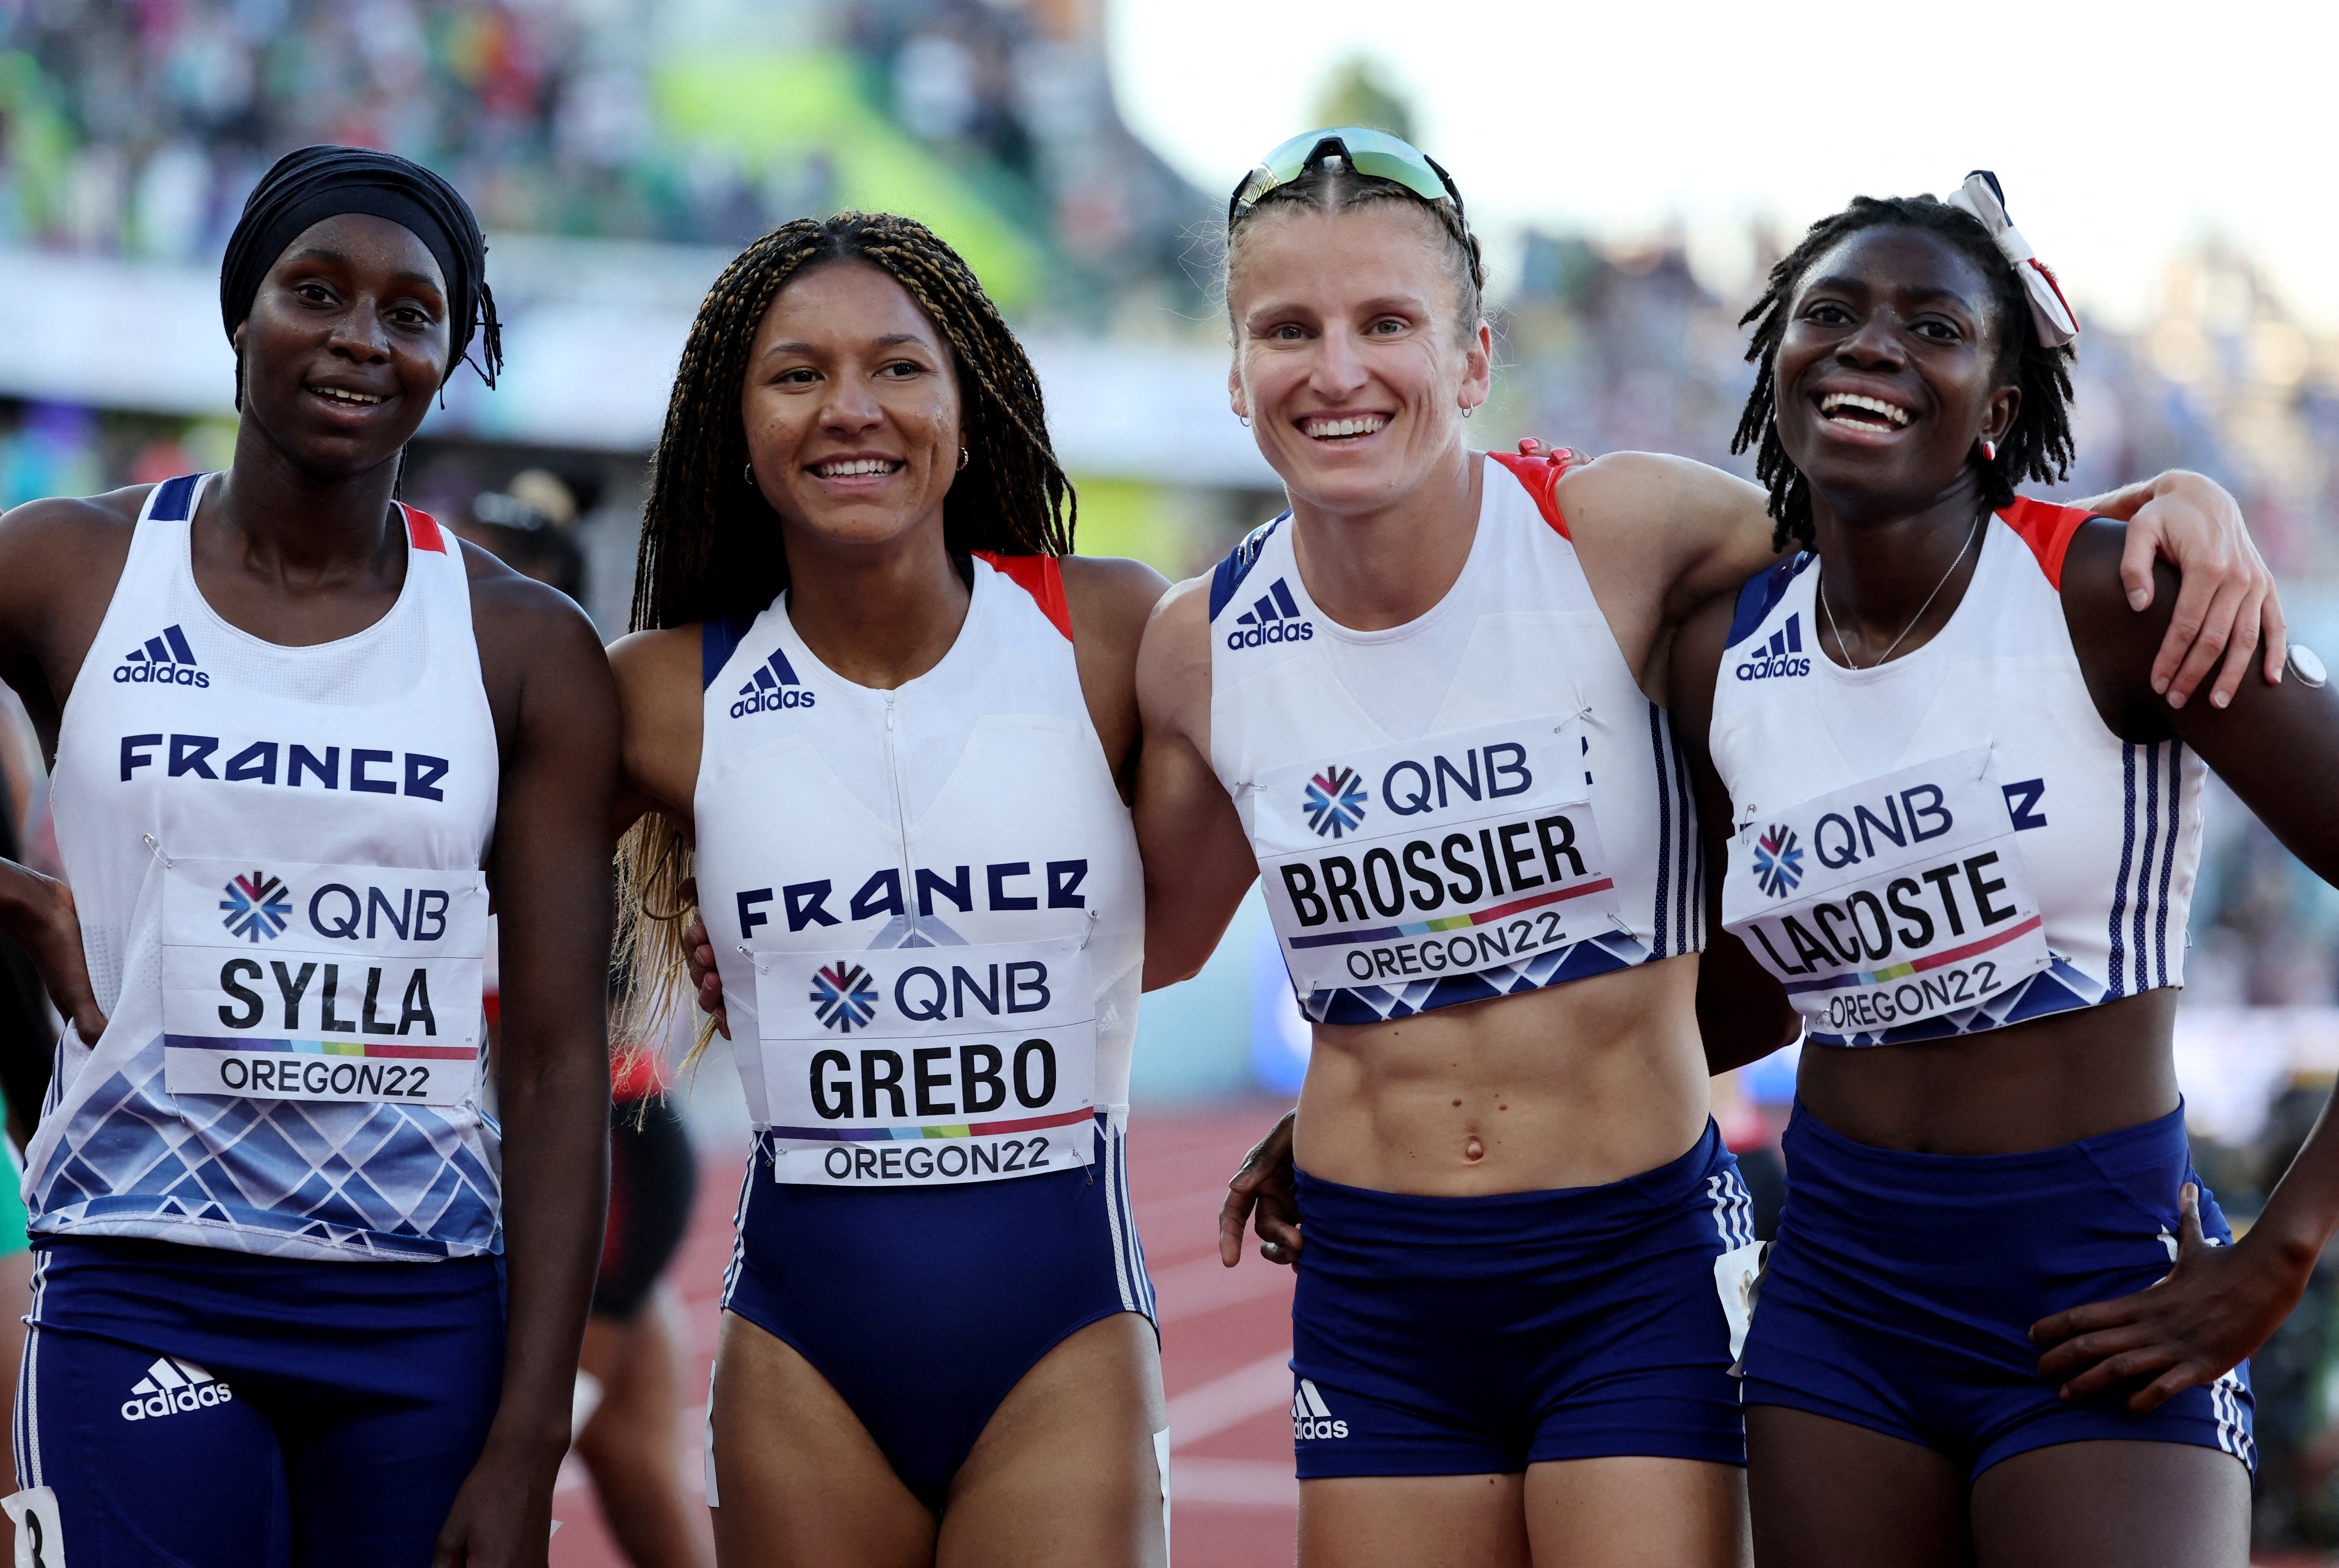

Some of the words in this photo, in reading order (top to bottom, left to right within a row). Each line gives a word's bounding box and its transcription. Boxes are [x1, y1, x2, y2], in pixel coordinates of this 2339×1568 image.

[1228, 618, 1313, 650] adidas
[113, 661, 210, 688] adidas
[1736, 654, 1810, 681] adidas
[730, 686, 815, 719] adidas
[120, 734, 449, 802] FRANCE
[1382, 743, 1532, 816] QNB
[1814, 784, 1953, 869] QNB
[736, 859, 1088, 939] FRANCE
[1280, 815, 1588, 927] BROSSIER
[308, 883, 449, 941] QNB
[1748, 850, 2017, 975] LACOSTE
[1346, 911, 1567, 980] OREGON22
[218, 958, 437, 1036] SYLLA
[894, 961, 1051, 1021] QNB
[1830, 961, 2002, 1029] OREGON22
[220, 1058, 430, 1098] OREGON22
[809, 1039, 1057, 1120] GREBO
[824, 1137, 1050, 1179] OREGON22
[121, 1383, 232, 1421] adidas
[1293, 1416, 1349, 1440] didas
